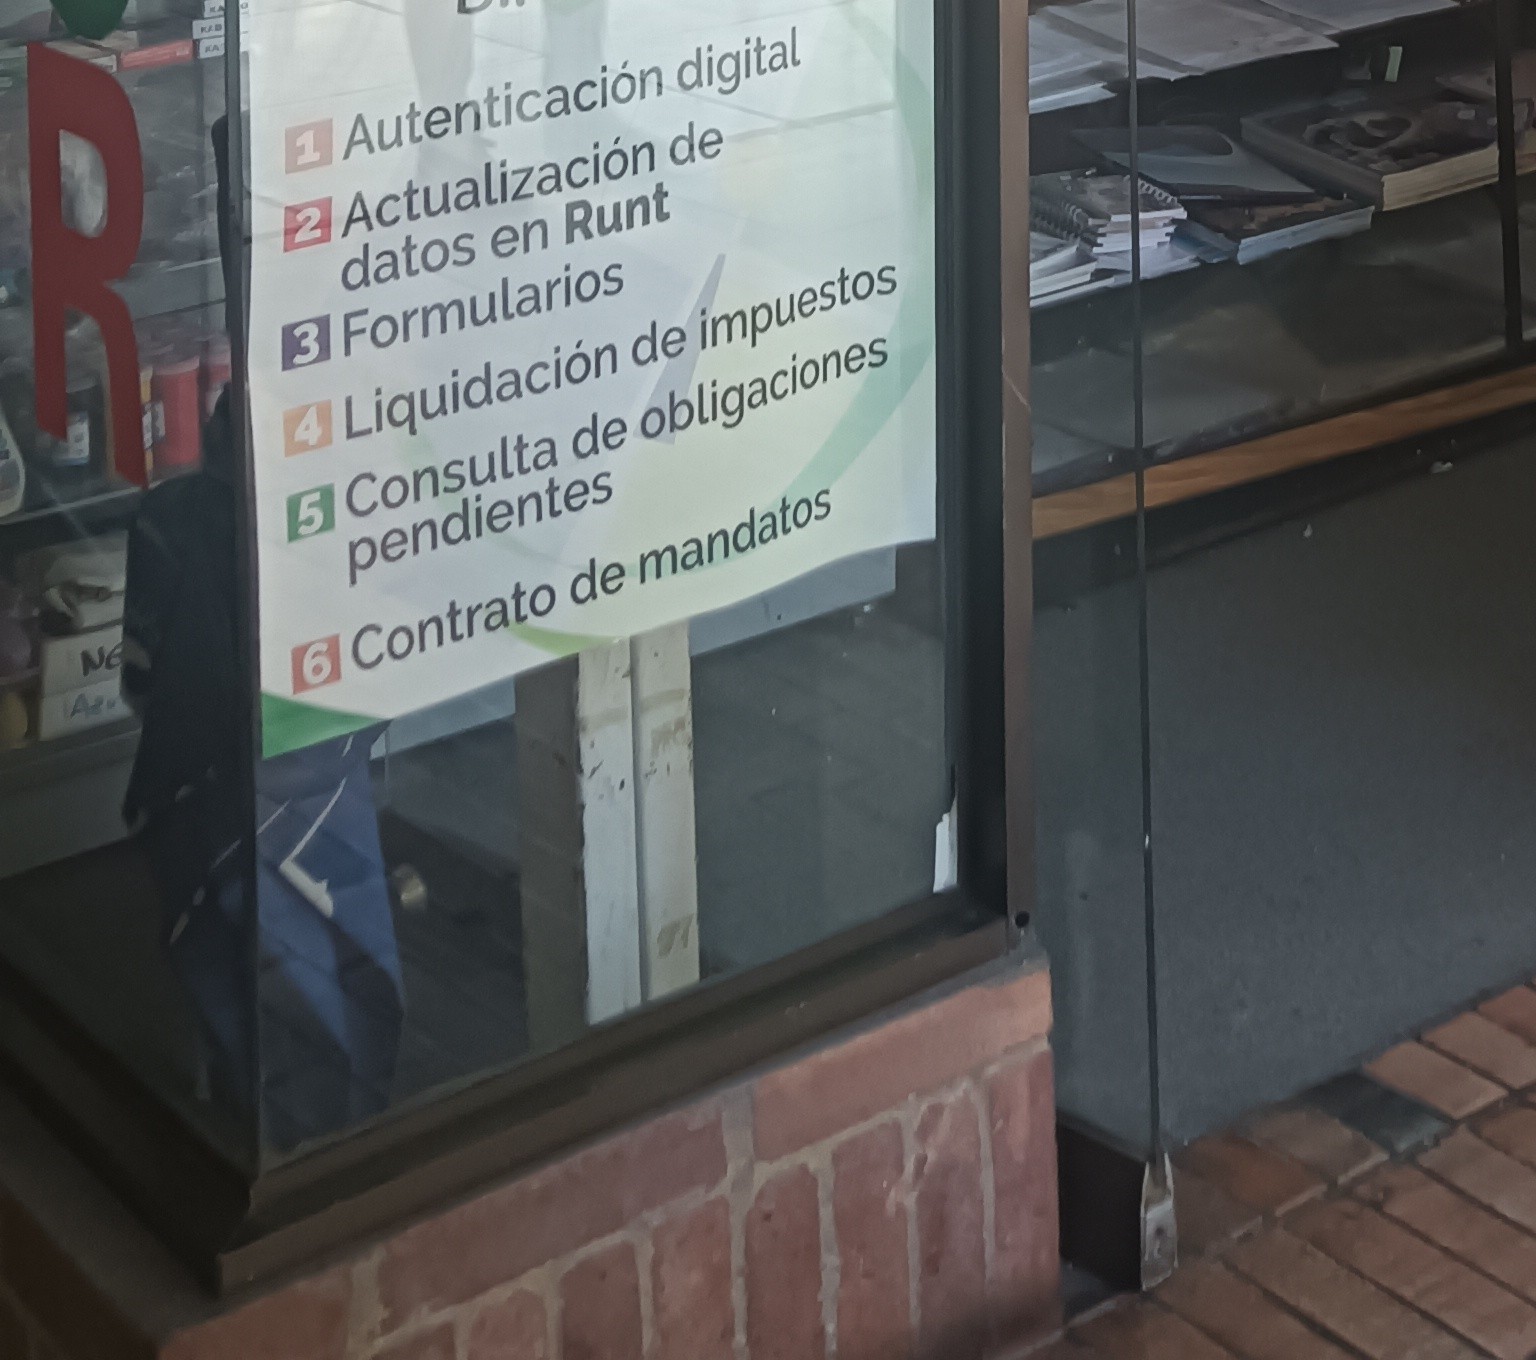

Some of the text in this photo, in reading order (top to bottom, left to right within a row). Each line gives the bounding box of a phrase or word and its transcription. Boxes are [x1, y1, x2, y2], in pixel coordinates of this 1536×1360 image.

[294, 26, 802, 166] 1 Autenticación digital
[295, 119, 725, 245] 2 Actualización de
[340, 182, 671, 292] datos en Runt
[291, 257, 625, 365] 3 Formularios
[294, 260, 898, 447] 4 Liquidación de impuestos
[296, 332, 889, 534] 5 Consulta de obligaciones
[302, 484, 833, 684] 6 Contrato de mandatos
[346, 468, 614, 585] pendientes
